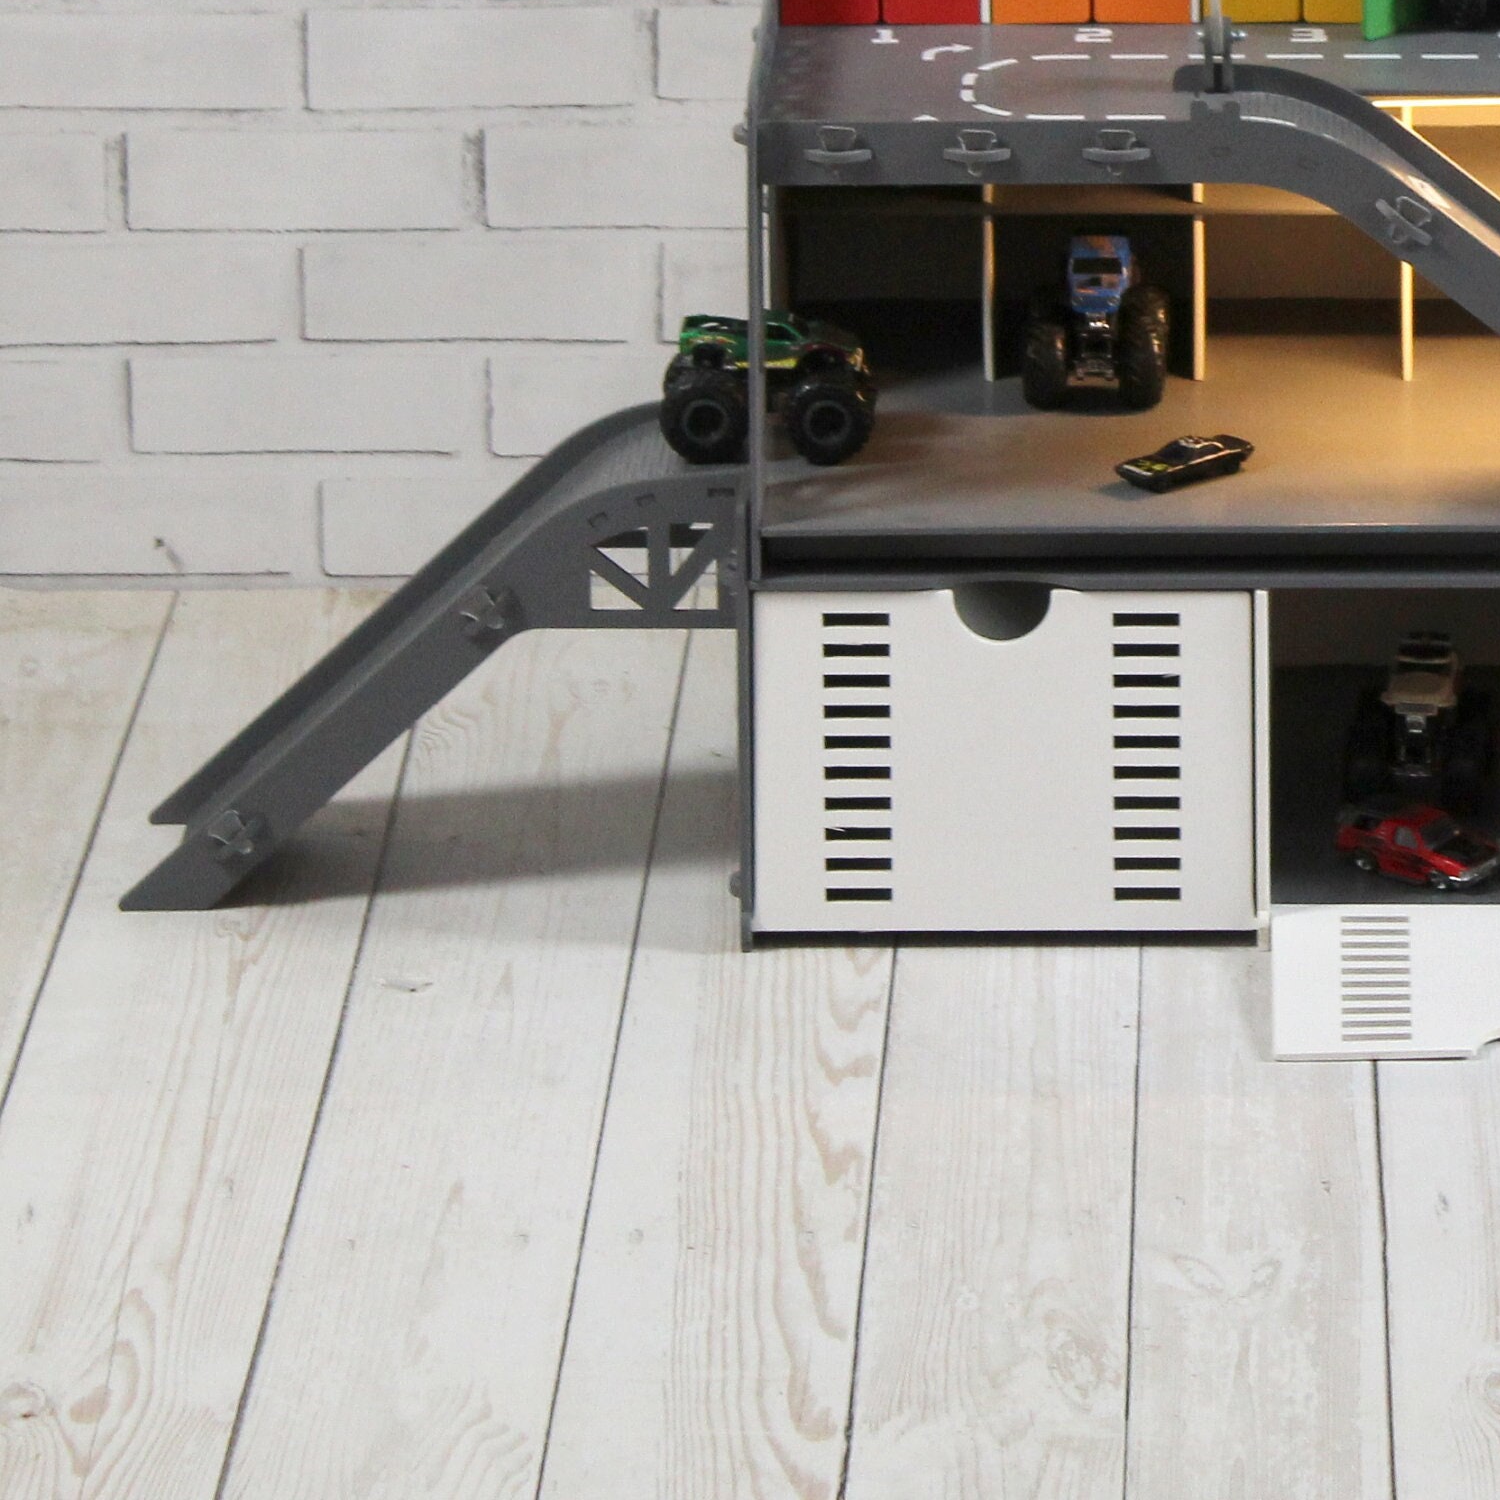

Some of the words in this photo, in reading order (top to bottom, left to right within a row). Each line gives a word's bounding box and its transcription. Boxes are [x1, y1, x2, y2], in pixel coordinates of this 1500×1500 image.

[871, 29, 900, 44] 1
[1074, 27, 1113, 43] 2
[1290, 28, 1328, 43] 3
